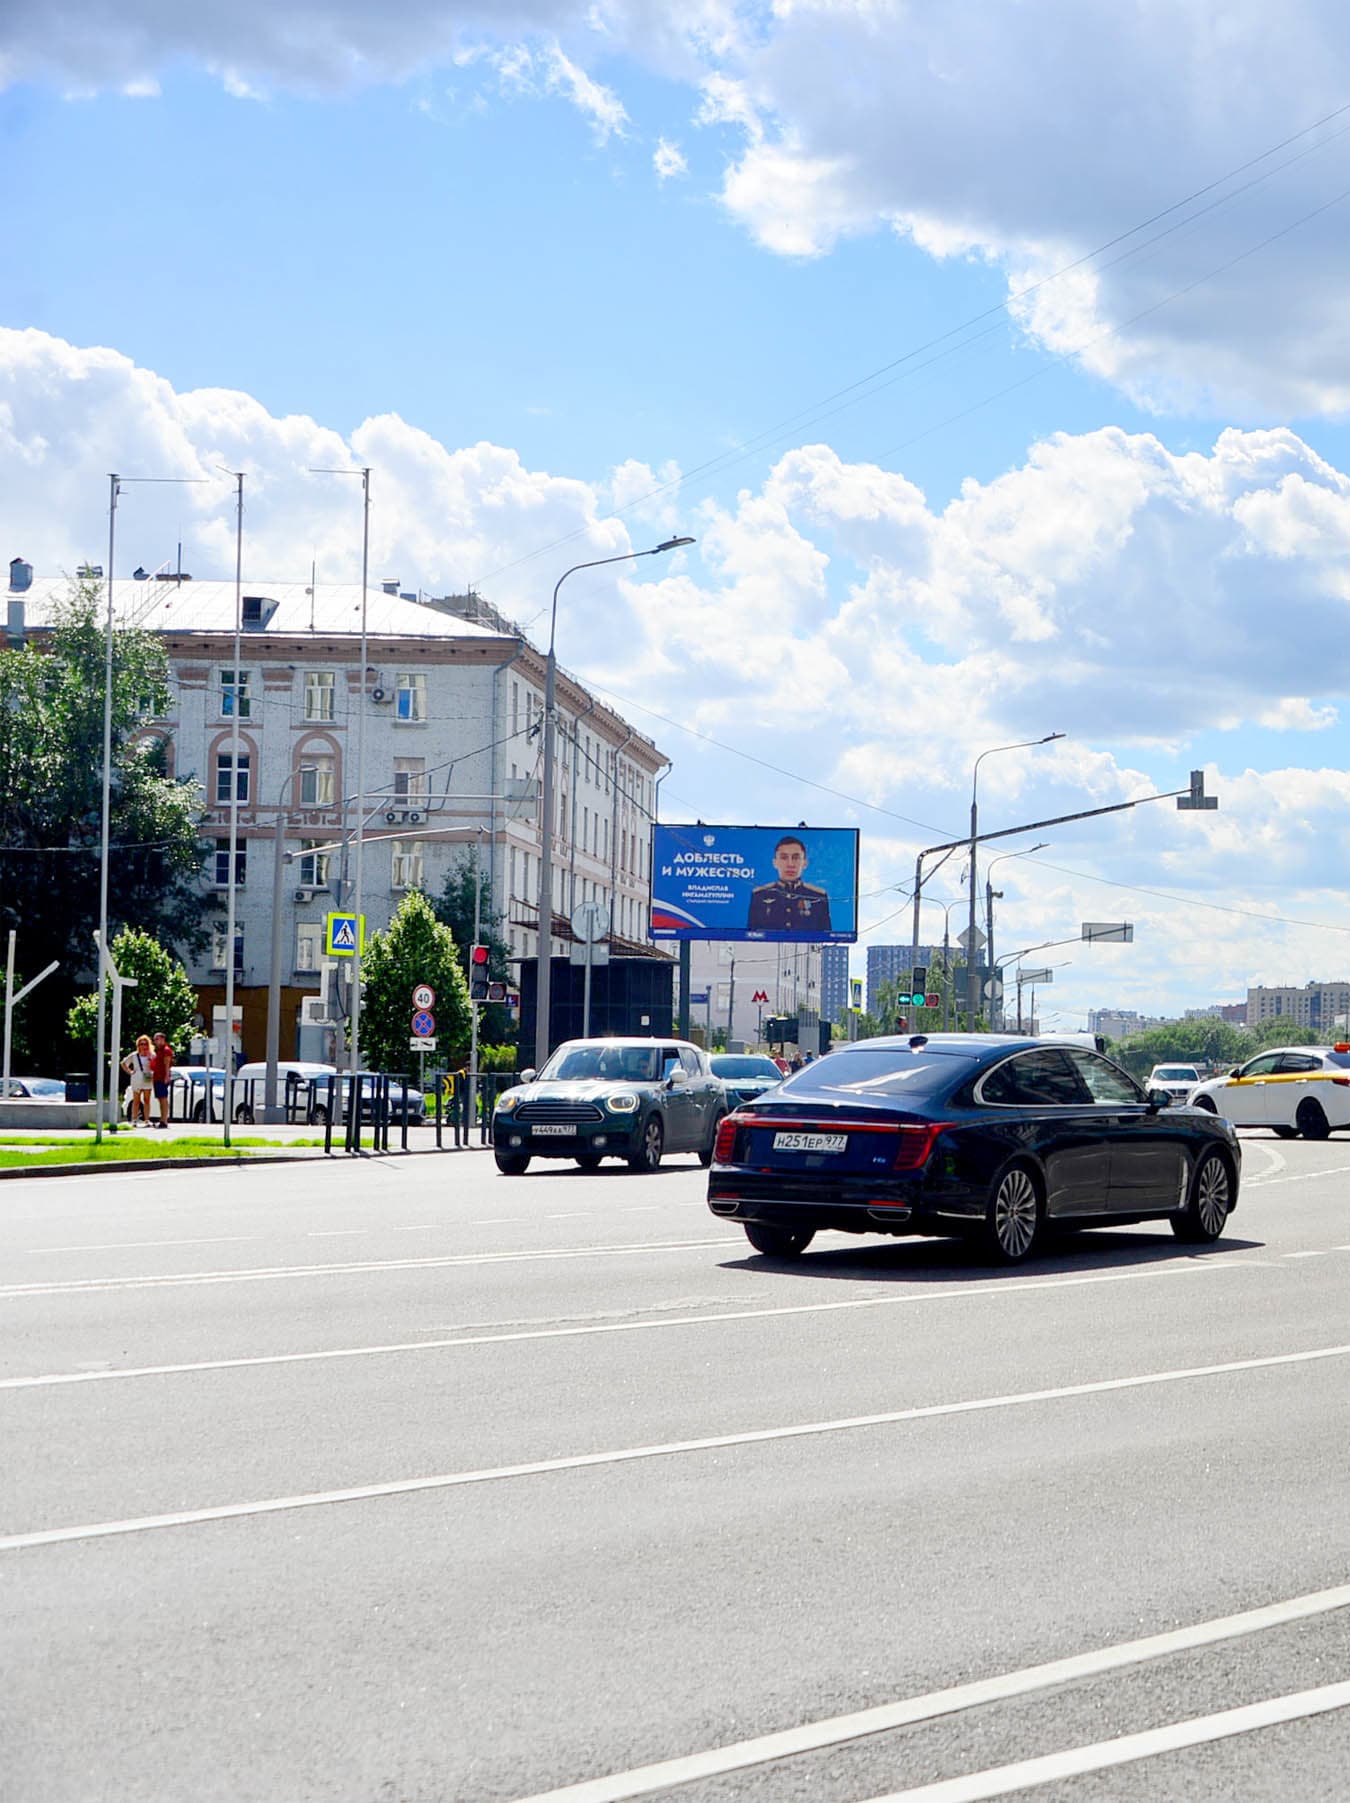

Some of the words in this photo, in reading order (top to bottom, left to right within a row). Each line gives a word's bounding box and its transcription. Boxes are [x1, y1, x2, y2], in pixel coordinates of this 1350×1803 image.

[673, 853, 744, 864] ДОБЛЕСТЬ
[662, 866, 672, 876] И
[675, 866, 755, 879] МУЖЕСТВО!
[417, 993, 430, 1004] 40
